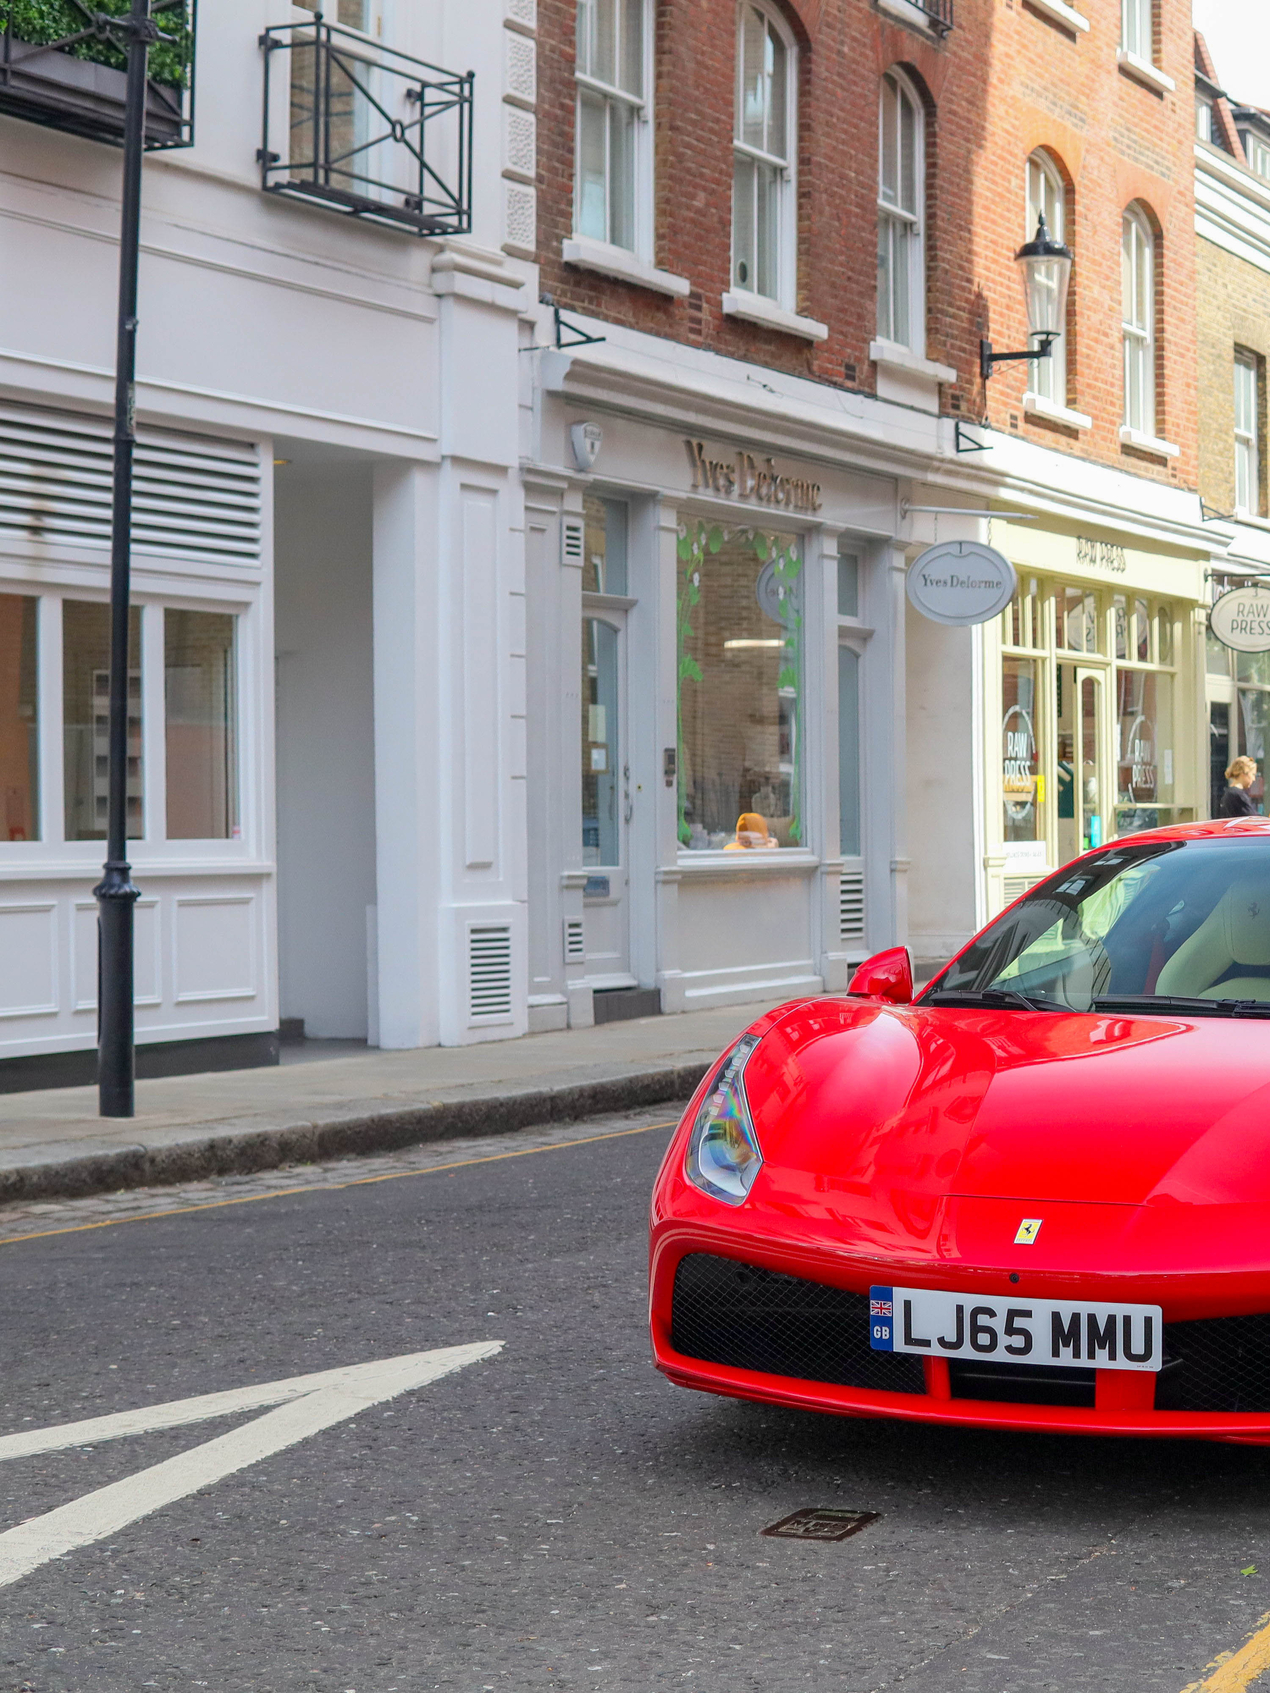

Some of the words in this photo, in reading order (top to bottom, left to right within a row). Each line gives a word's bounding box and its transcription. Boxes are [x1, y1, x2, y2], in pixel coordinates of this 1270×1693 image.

[683, 439, 735, 494] Yves
[736, 451, 822, 511] Delorme
[922, 574, 948, 588] Yves
[950, 574, 1002, 589] Delorme
[1236, 602, 1270, 618] RAW
[1007, 732, 1028, 758] RAW
[1004, 760, 1031, 786] PRESS
[873, 1325, 890, 1340] GB
[903, 1299, 1033, 1357] LJ65
[1050, 1311, 1153, 1363] MMU
